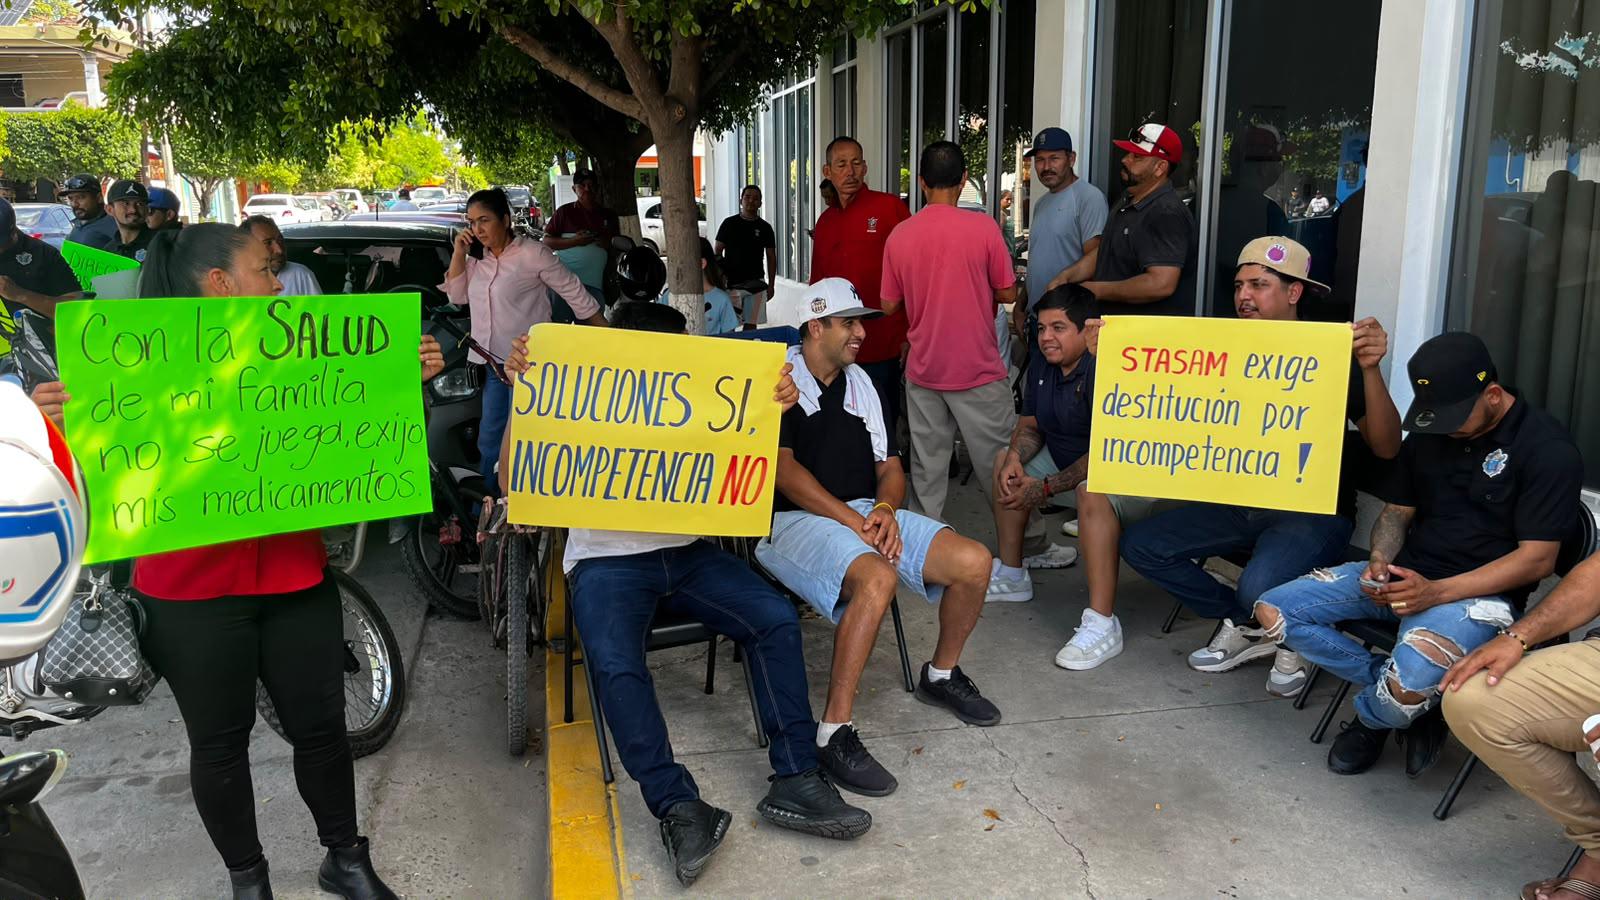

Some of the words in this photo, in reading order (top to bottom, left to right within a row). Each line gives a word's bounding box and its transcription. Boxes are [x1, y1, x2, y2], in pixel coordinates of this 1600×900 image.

[82, 312, 168, 367] Con
[195, 307, 235, 363] la
[259, 299, 389, 361] SALUD
[91, 382, 147, 423] de
[170, 378, 213, 411] mi
[238, 362, 366, 412] familia
[515, 361, 692, 427] SOLUCIONES
[708, 376, 756, 435] SI,
[1121, 346, 1228, 377] STASAM
[1244, 353, 1318, 391] exige
[1102, 383, 1240, 426] destitución
[1262, 402, 1310, 436] por
[100, 440, 161, 473] no
[184, 432, 240, 464] se
[356, 413, 423, 464] exijo
[511, 440, 715, 504] INCOMPETENCIA
[718, 455, 768, 505] NO
[1102, 435, 1280, 477] incompetencia
[112, 488, 177, 529] mis
[203, 460, 422, 516] medicamentos.
